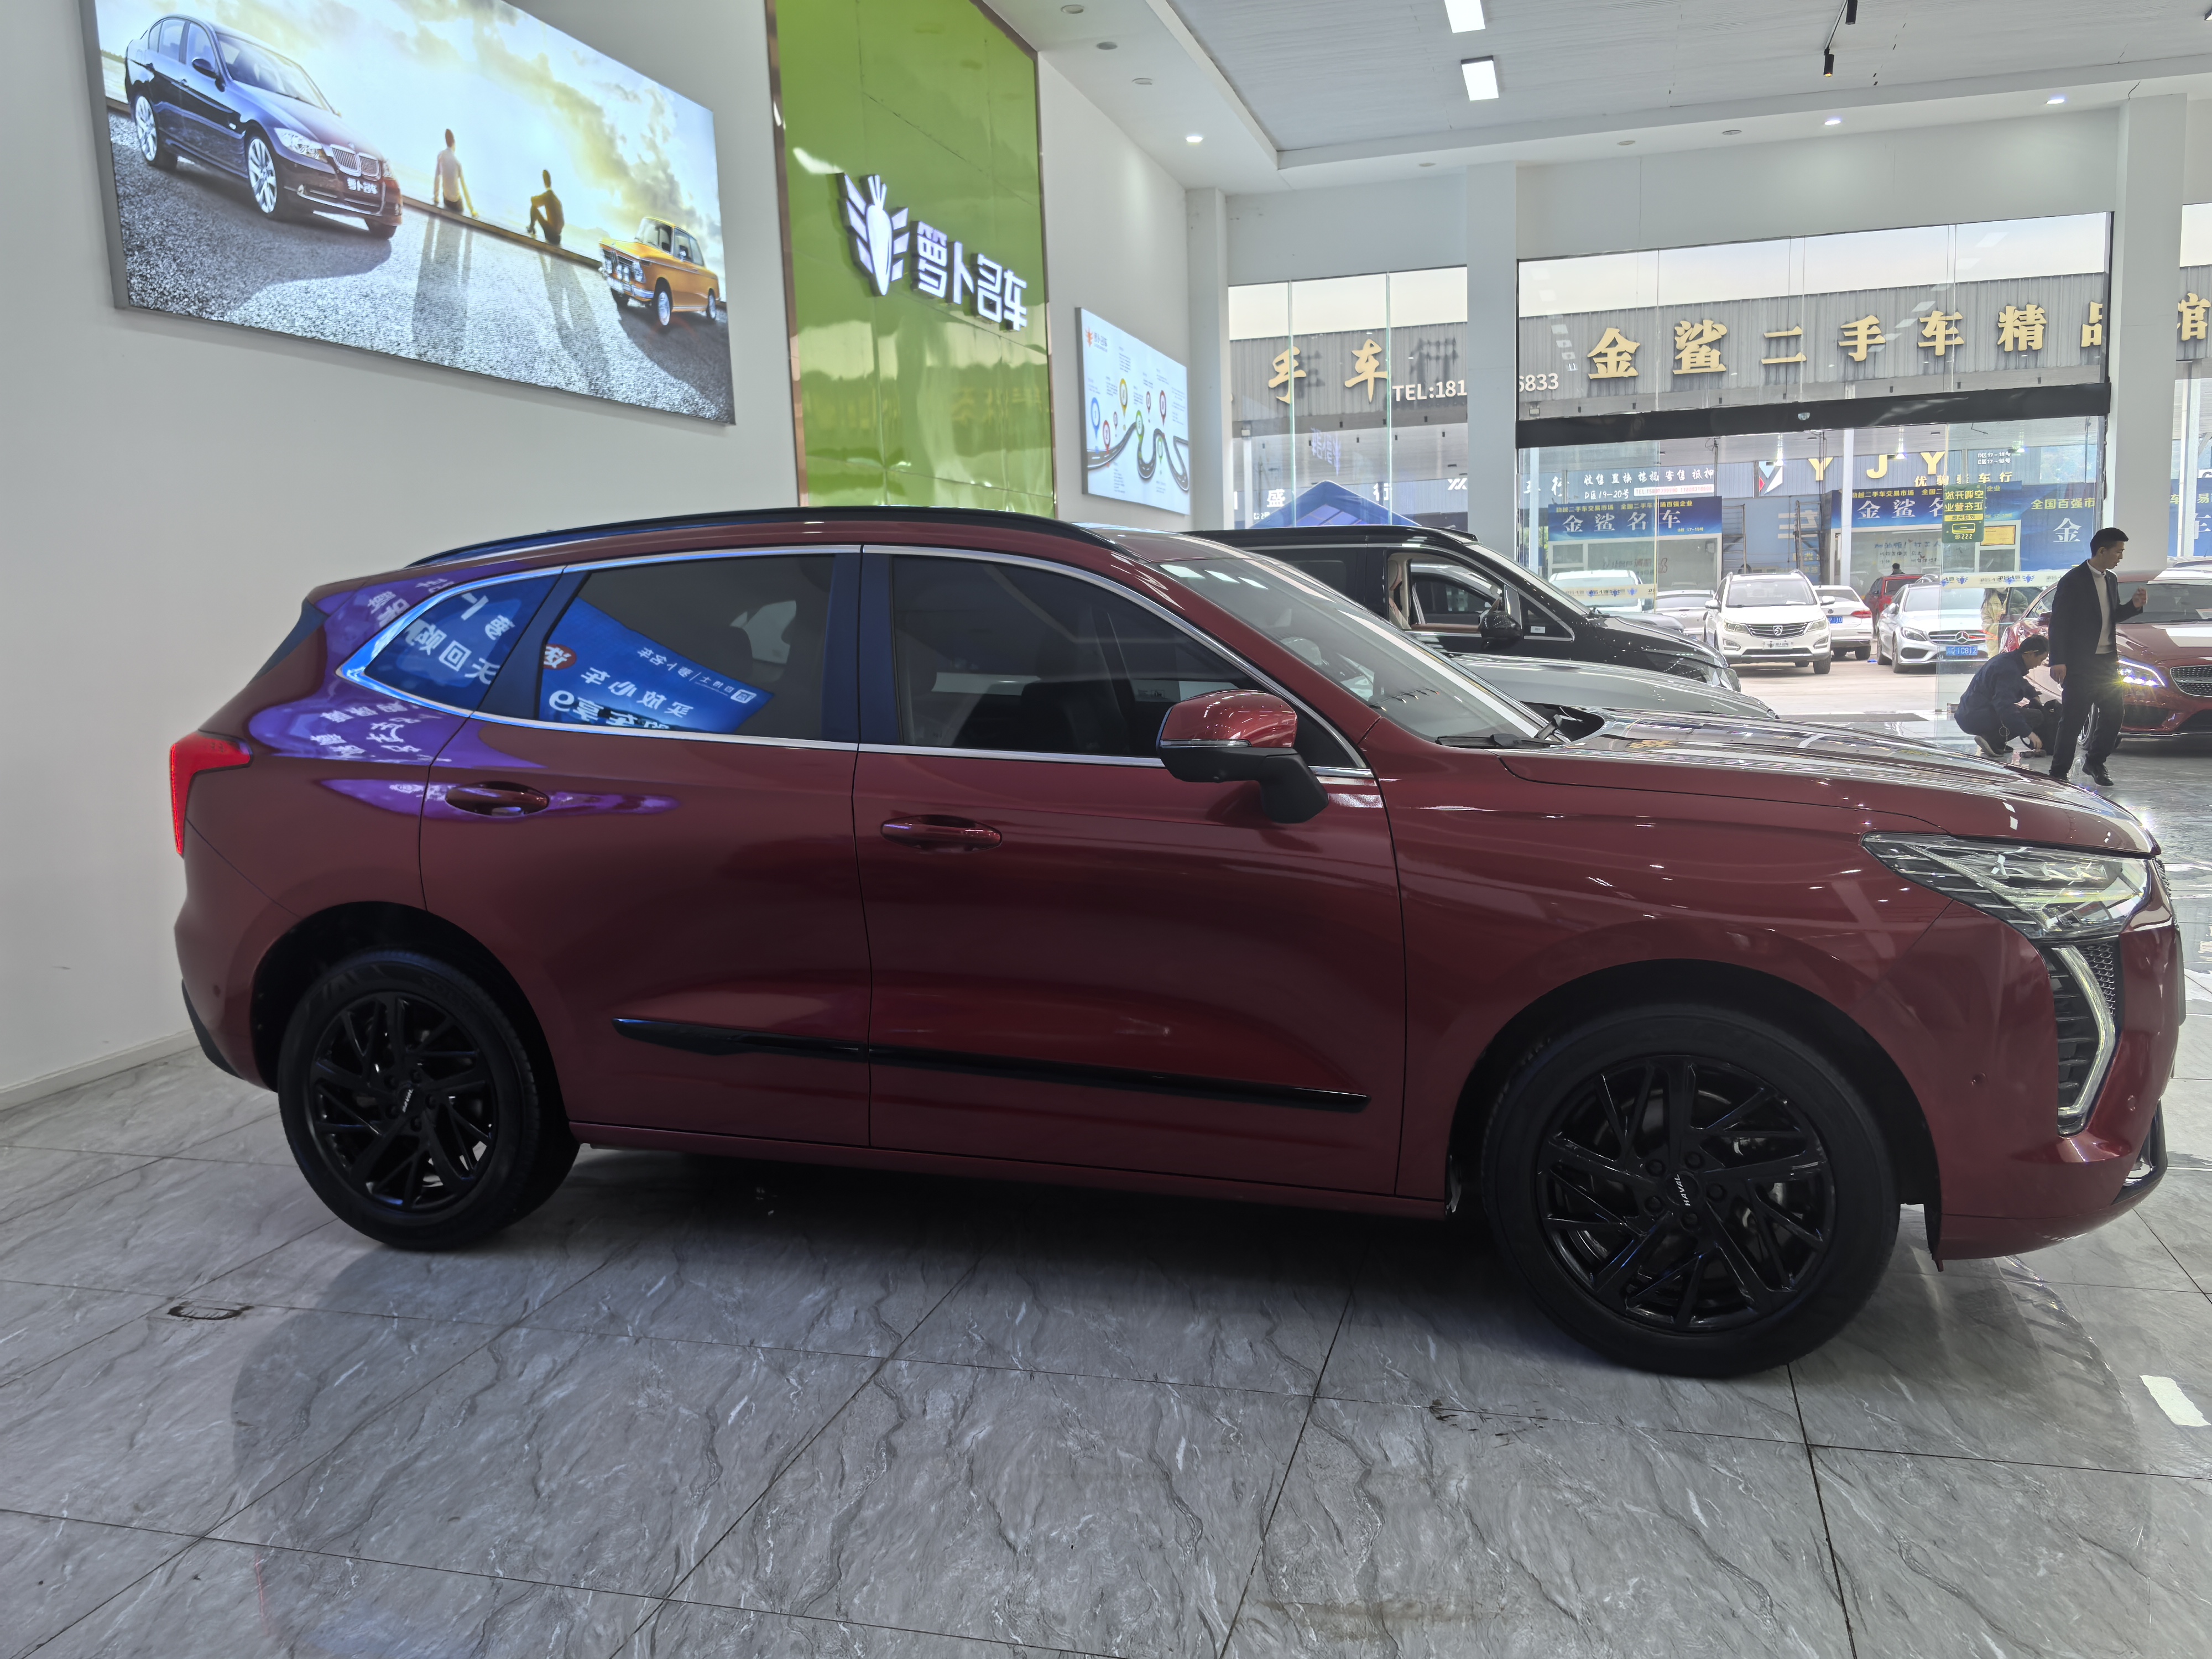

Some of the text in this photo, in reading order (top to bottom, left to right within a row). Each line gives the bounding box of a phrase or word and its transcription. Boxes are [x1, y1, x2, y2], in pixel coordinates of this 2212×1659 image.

[1620, 500, 1693, 510] 全国二手车场百强企业
[1674, 1173, 1691, 1206] HAVAL
